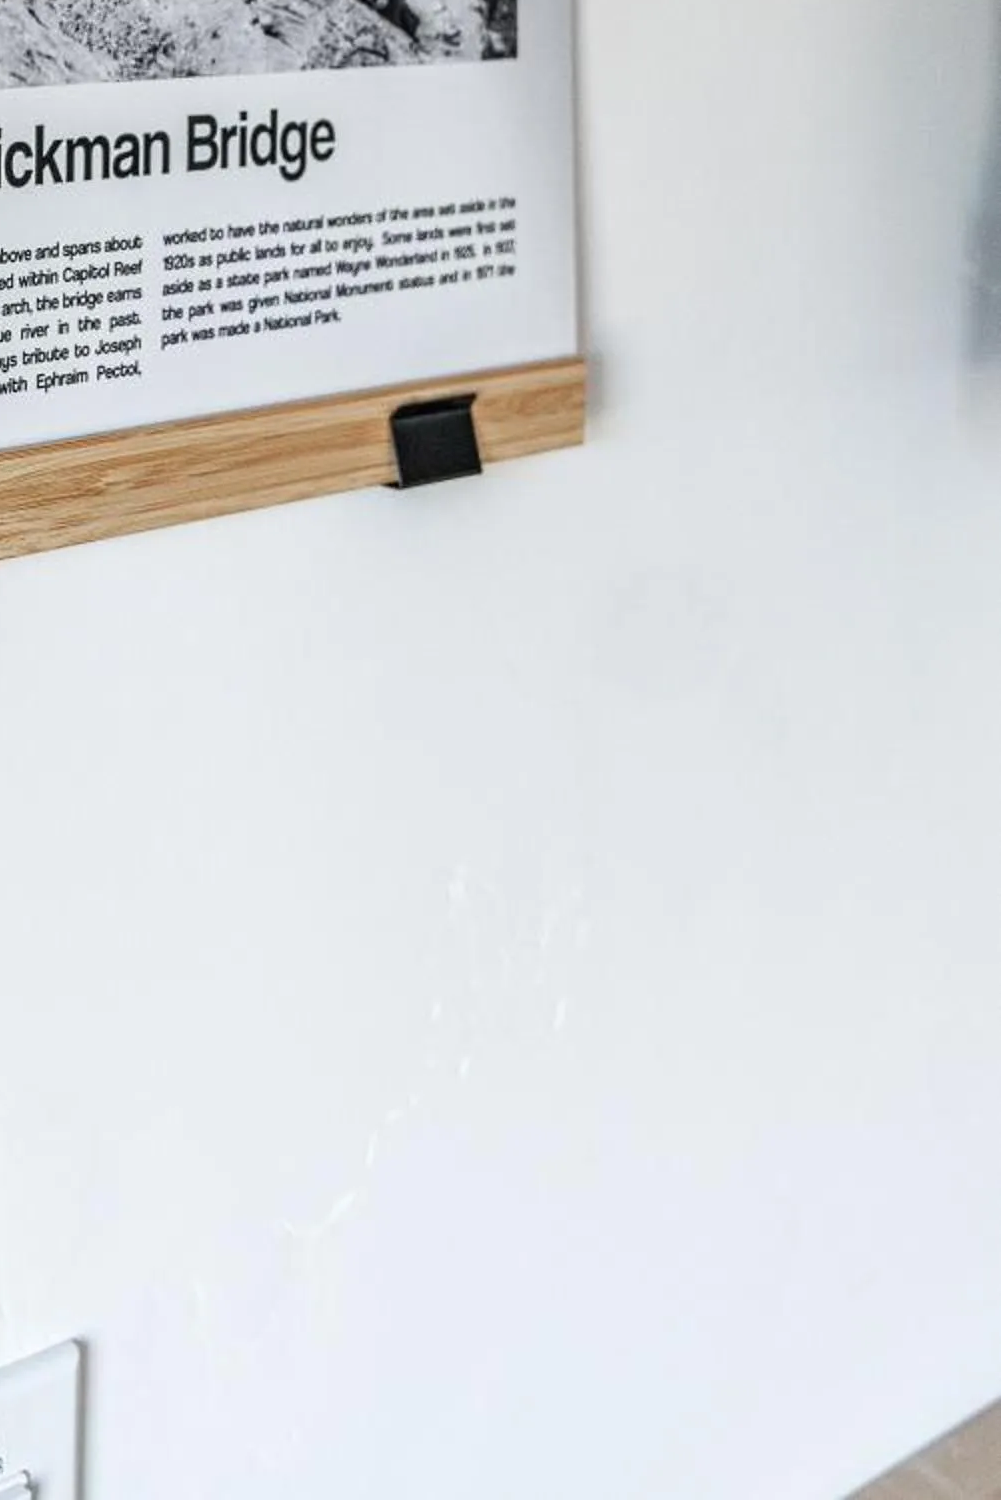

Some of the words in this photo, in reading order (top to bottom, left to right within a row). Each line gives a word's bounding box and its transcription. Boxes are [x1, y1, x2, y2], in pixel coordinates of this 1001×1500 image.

[186, 109, 336, 181] Bridge
[163, 228, 207, 246] worked
[209, 228, 225, 241] to
[227, 224, 255, 239] have
[259, 221, 280, 236] the
[283, 215, 324, 232] natural
[327, 212, 373, 228] wonders
[375, 208, 388, 224] of
[35, 241, 60, 260] and
[62, 241, 102, 261] spans
[104, 235, 143, 252] about
[163, 253, 196, 271] 1920s
[198, 254, 213, 268] as
[216, 246, 251, 270] public
[254, 244, 287, 260] lands
[290, 242, 306, 256] for
[309, 238, 322, 254] all
[325, 240, 339, 253] to
[18, 268, 59, 288] within
[62, 262, 110, 286] Capitol
[114, 258, 143, 276] Reef
[162, 278, 195, 296] aside
[197, 279, 212, 292] as
[215, 277, 223, 290] a
[226, 272, 261, 288] state
[263, 266, 290, 288] park
[293, 262, 332, 280] named
[335, 260, 371, 278] Wayne
[375, 250, 438, 269] Wonderland
[1, 298, 33, 316] arch,
[36, 295, 59, 312] the
[62, 290, 104, 310] bridge
[107, 288, 143, 303] earns
[161, 304, 184, 322] the
[188, 300, 215, 322] park
[219, 299, 244, 313] was
[247, 294, 280, 314] given
[283, 285, 332, 305] National
[335, 279, 394, 298] Monument
[21, 324, 50, 340] river
[57, 319, 69, 335] in
[77, 316, 101, 332] the
[109, 311, 142, 333] past.
[161, 328, 188, 351] park
[191, 327, 215, 342] was
[218, 320, 251, 337] made
[253, 321, 261, 333] a
[263, 312, 313, 331] National
[22, 346, 69, 366] tribute
[74, 344, 91, 359] to
[95, 334, 141, 356] Joseph
[36, 368, 89, 394] Ephraim
